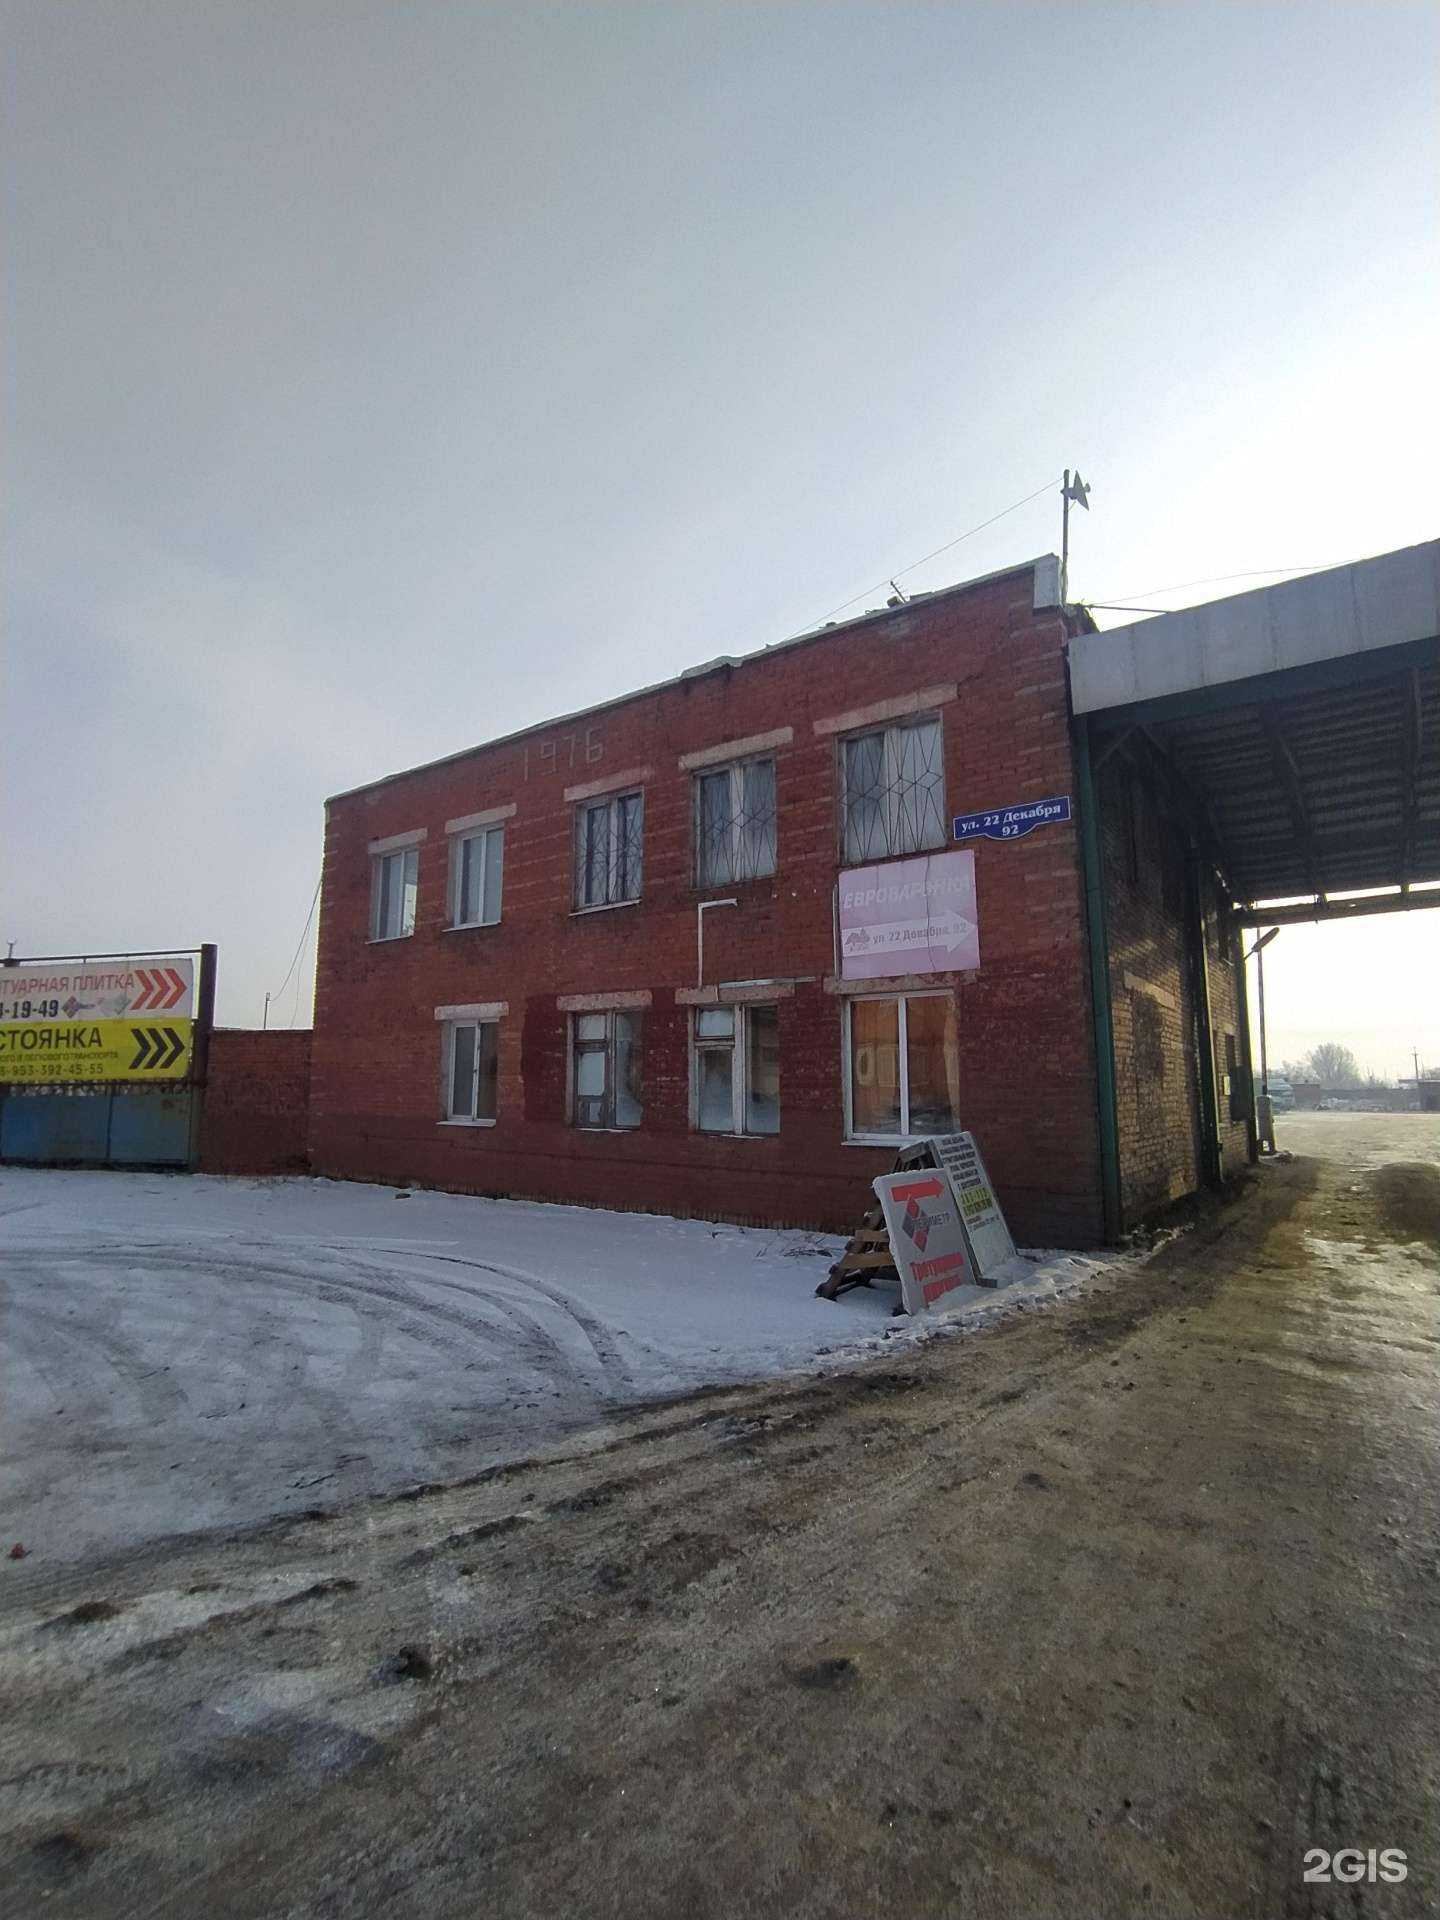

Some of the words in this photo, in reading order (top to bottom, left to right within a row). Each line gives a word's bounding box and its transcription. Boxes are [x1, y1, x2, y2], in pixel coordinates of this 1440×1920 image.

[523, 726, 604, 783] 1976
[961, 821, 980, 833] ул.
[983, 815, 1000, 827] 22
[1003, 803, 1061, 824] Декабря
[1002, 824, 1019, 836] 92
[888, 931, 901, 942] 22
[0, 977, 69, 994] ТУАРНАЯ
[73, 973, 135, 991] ПЛИТКА
